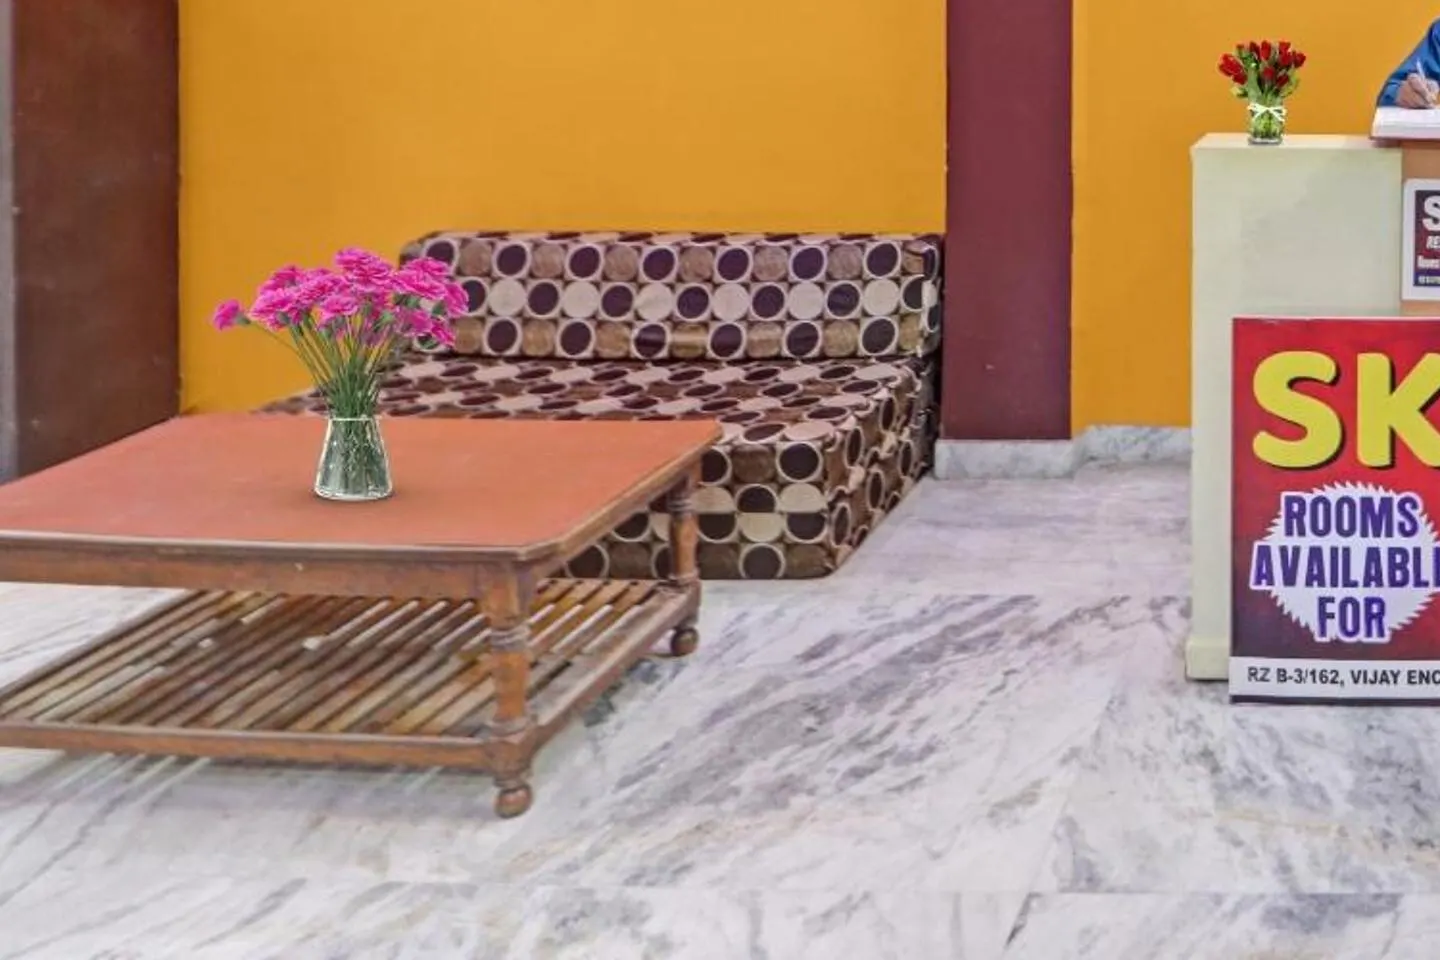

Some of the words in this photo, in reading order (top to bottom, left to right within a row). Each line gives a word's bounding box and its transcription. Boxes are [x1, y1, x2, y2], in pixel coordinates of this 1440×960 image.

[1283, 495, 1420, 538] ROOMS
[1317, 596, 1386, 639] FOR
[1248, 666, 1271, 683] RZ
[1277, 668, 1345, 687] B-3/162,
[1351, 669, 1400, 685] VIJAY
